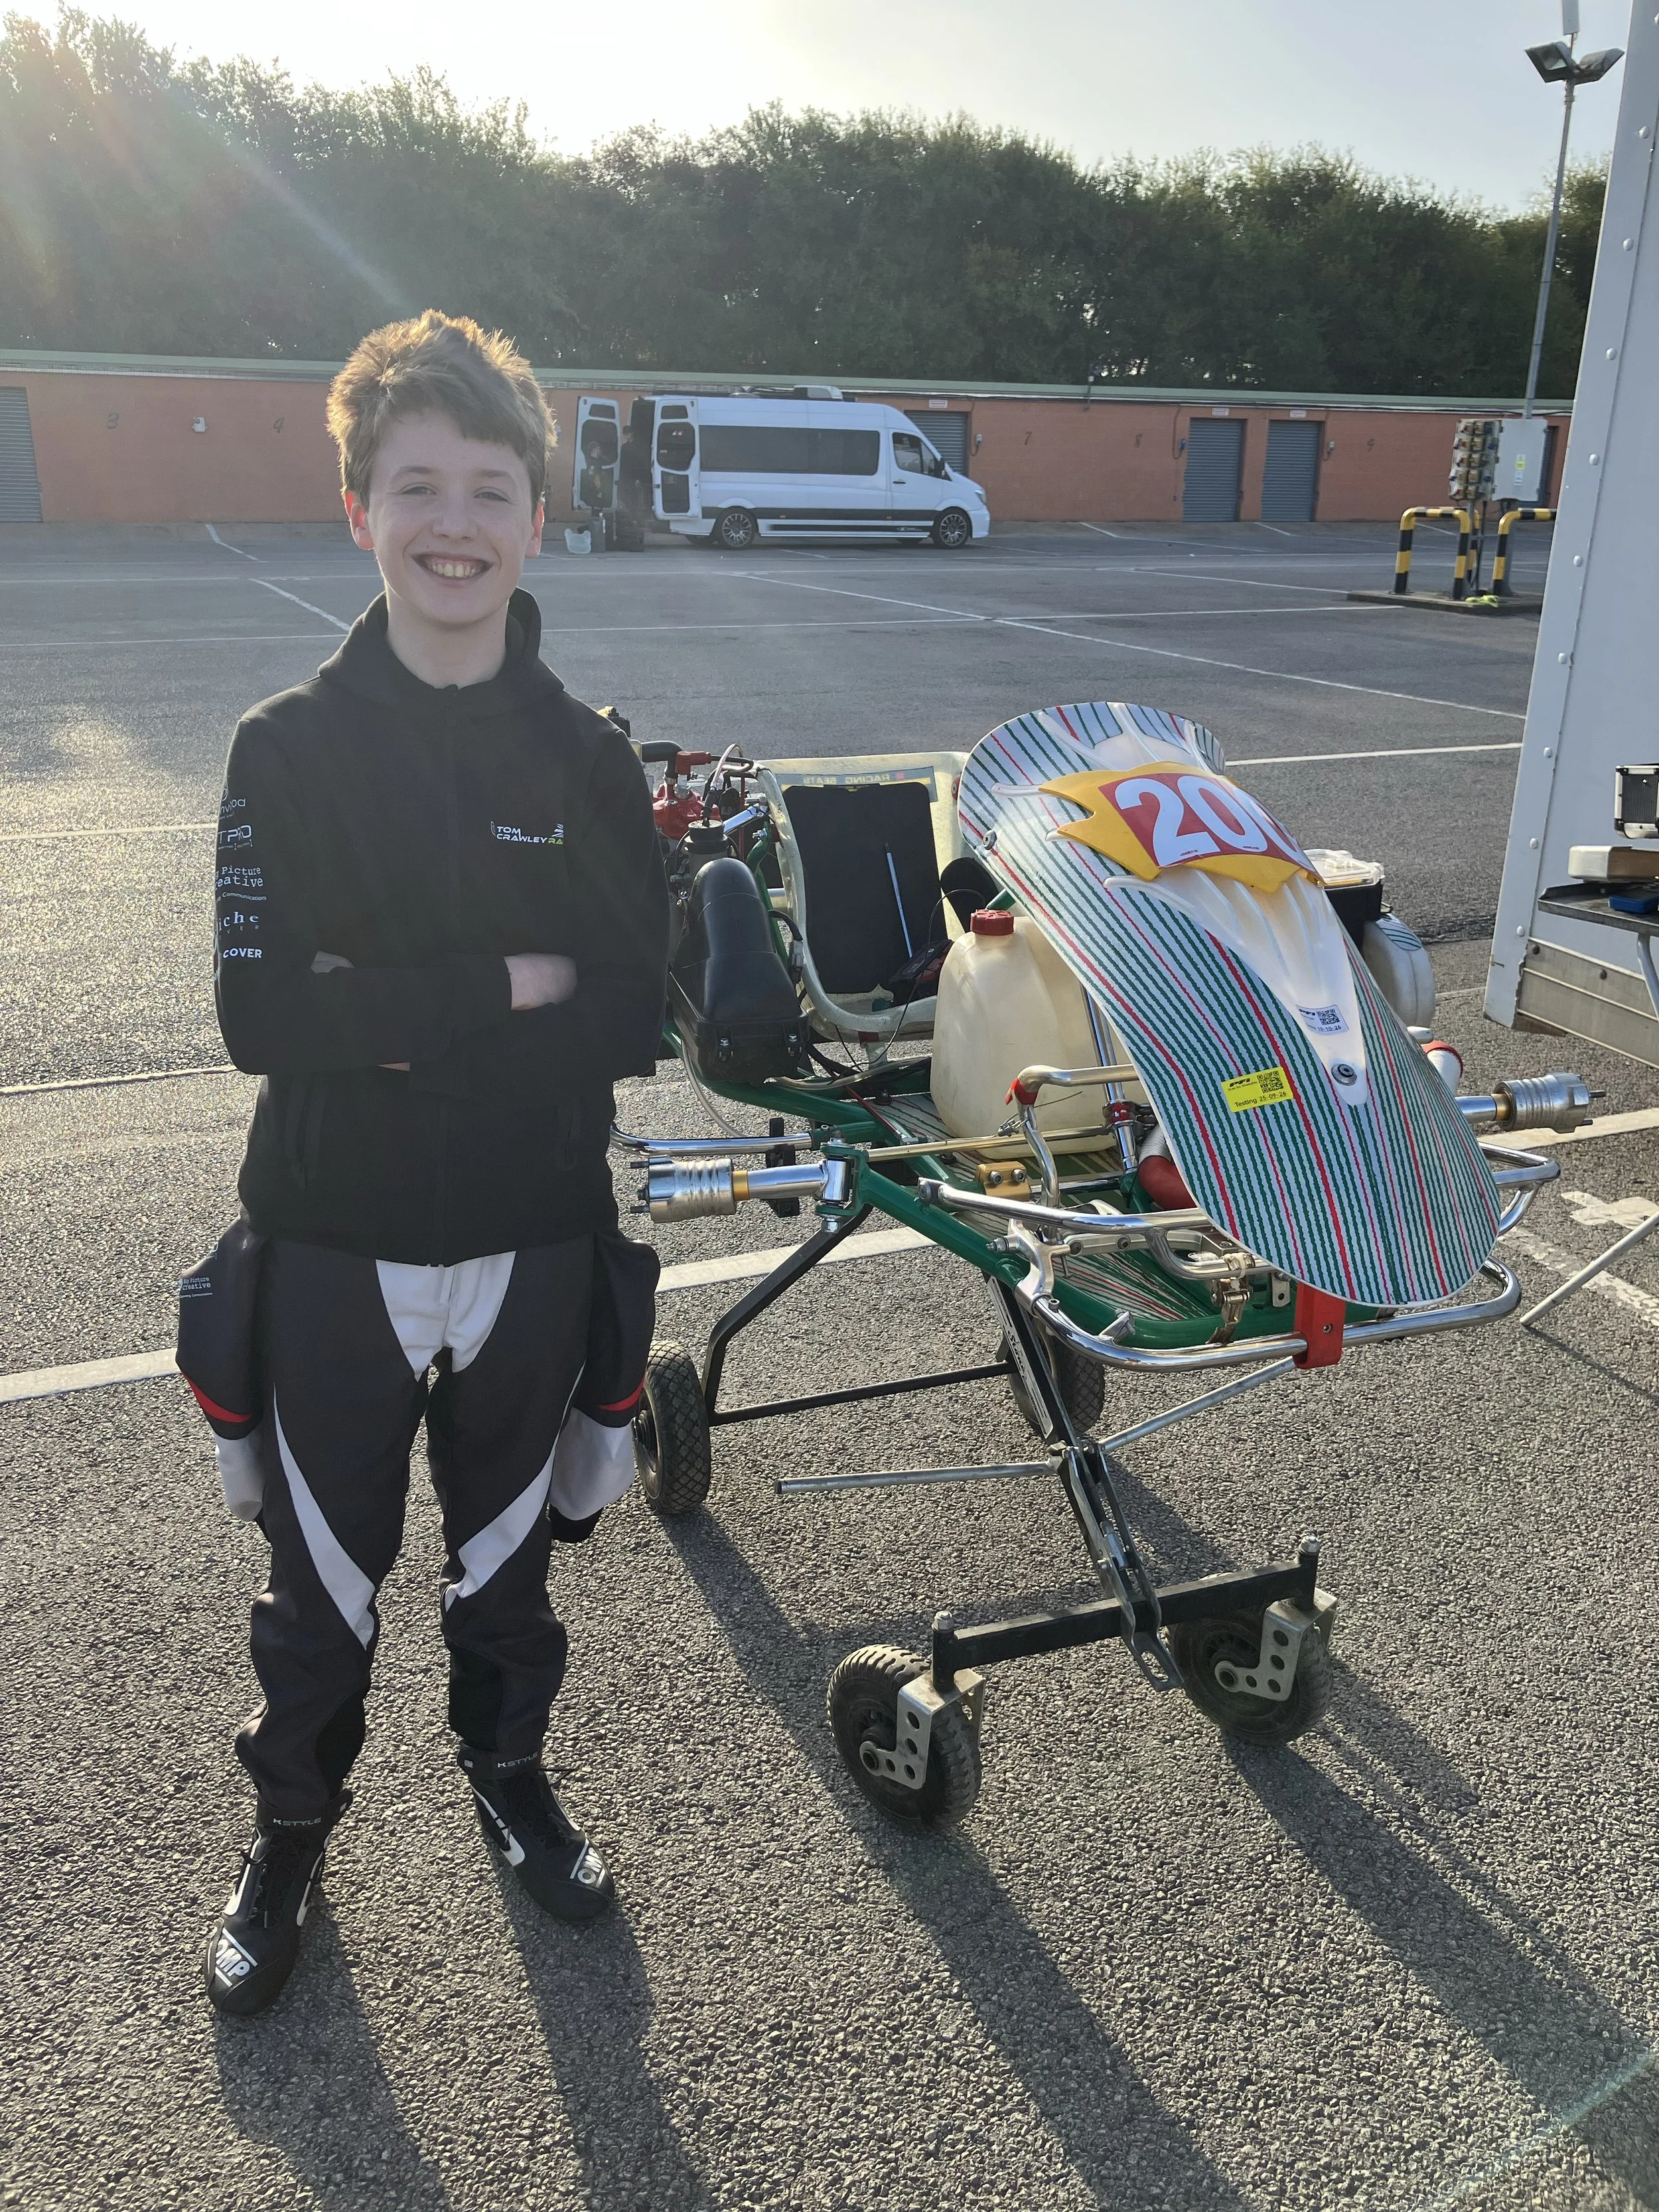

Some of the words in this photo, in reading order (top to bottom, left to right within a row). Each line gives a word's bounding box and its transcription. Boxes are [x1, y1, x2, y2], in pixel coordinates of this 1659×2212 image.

[106, 412, 119, 429] 3
[273, 417, 285, 433] 4
[1025, 431, 1033, 445] 7
[496, 826, 521, 834] TOM
[221, 865, 261, 875] Picture
[216, 875, 263, 890] reative
[222, 892, 267, 901] Communications
[218, 911, 259, 932] iche
[1234, 1098, 1258, 1108] Testing
[1258, 1091, 1287, 1102] 25-09-26
[182, 1282, 211, 1290] creative
